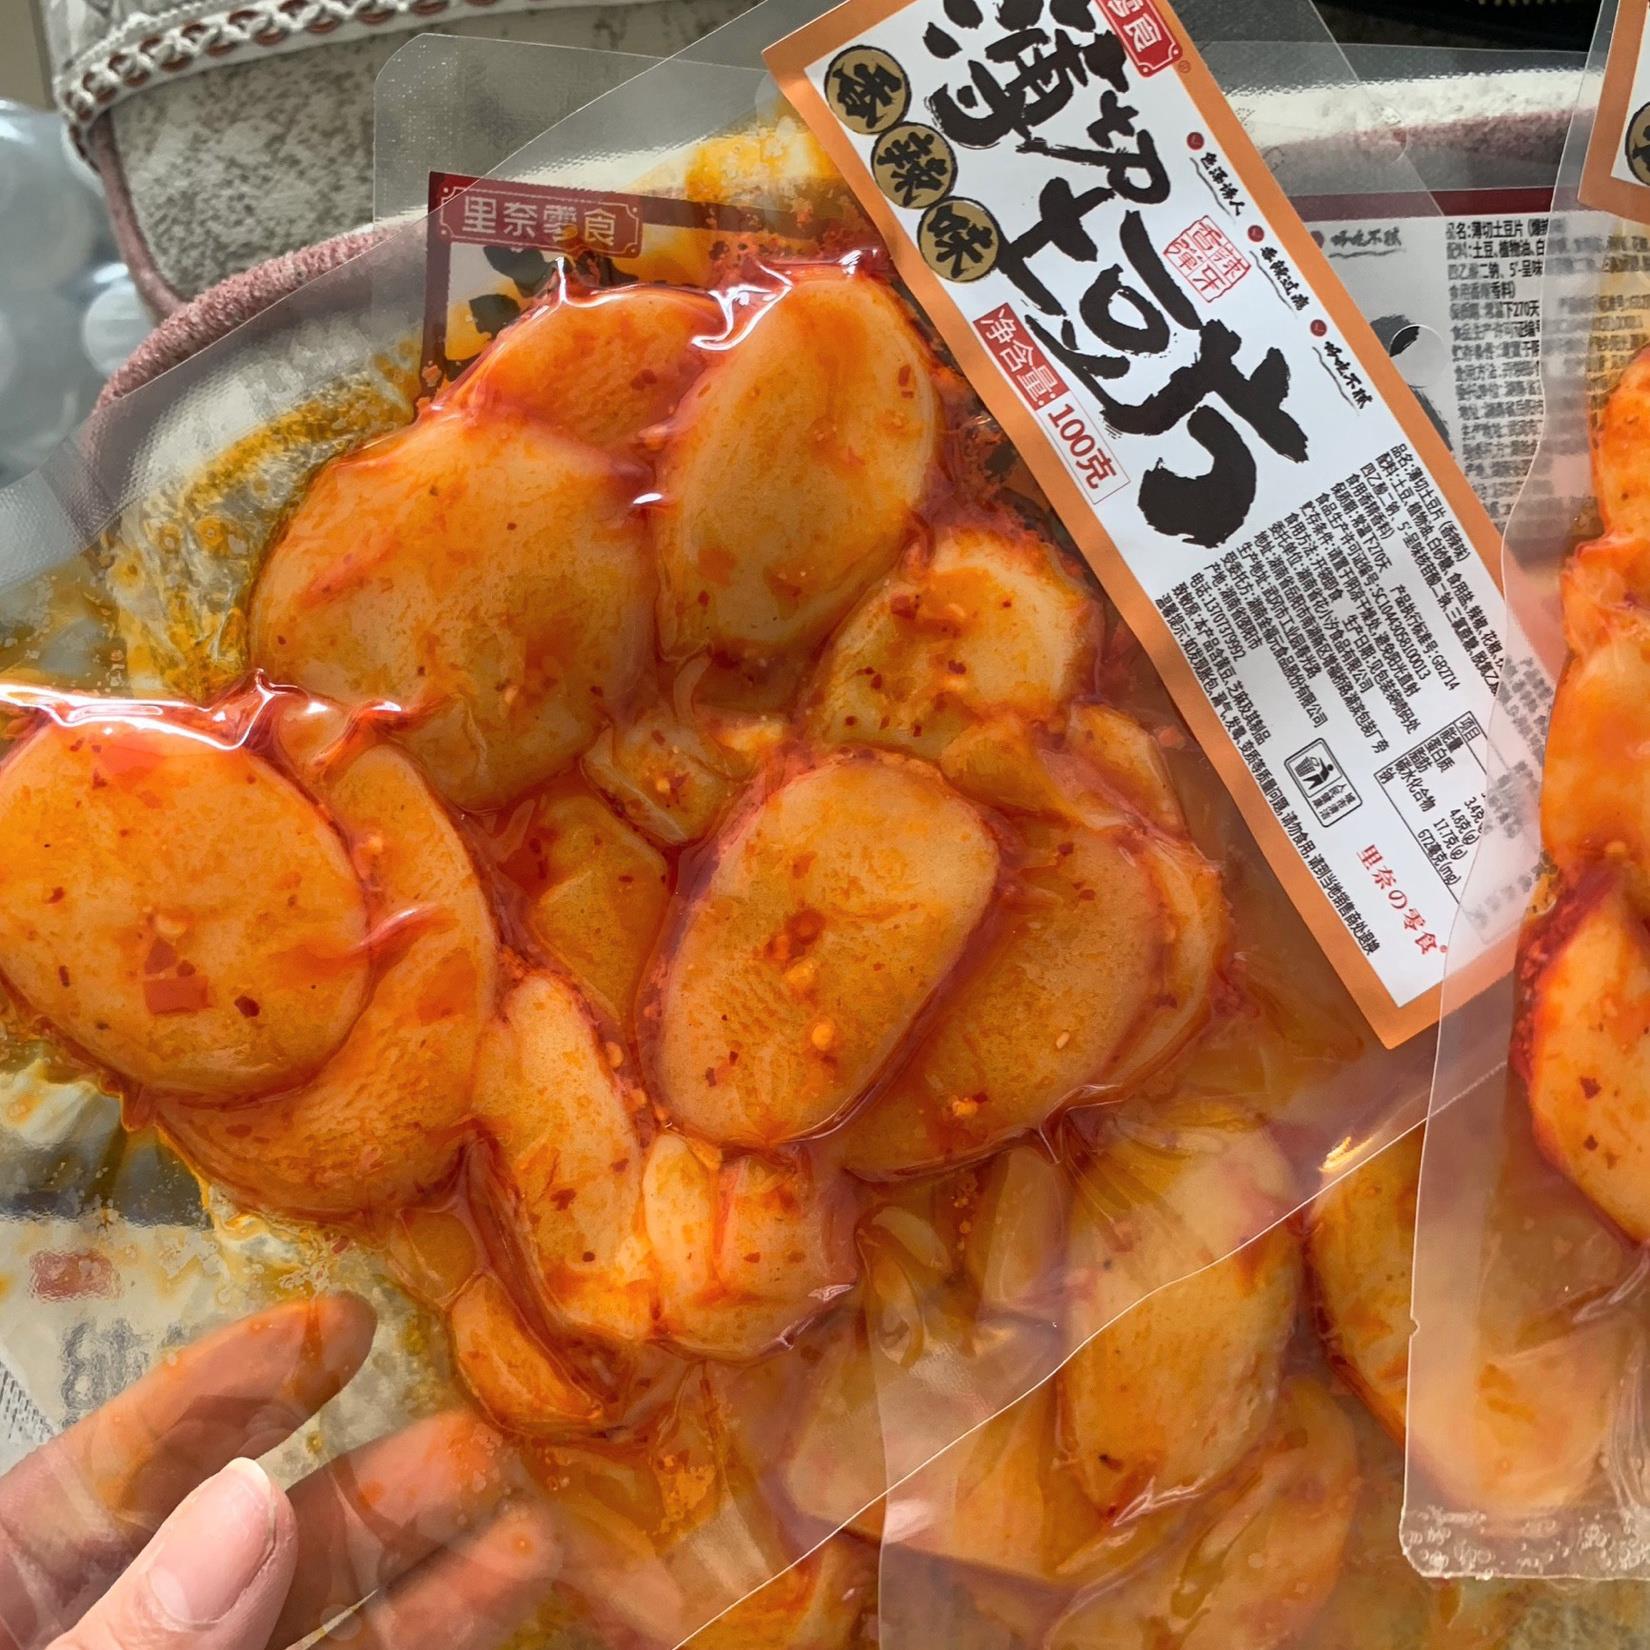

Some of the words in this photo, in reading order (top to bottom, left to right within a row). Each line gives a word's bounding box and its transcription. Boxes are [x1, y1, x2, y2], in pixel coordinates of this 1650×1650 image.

[833, 63, 993, 279] 香辣味
[462, 196, 616, 247] 里奈零食
[923, 0, 1307, 549] 薄切土豆片
[981, 309, 1058, 405] 净含量:
[1048, 404, 1116, 489] 100克
[1440, 727, 1464, 753] 能量
[1458, 717, 1480, 743] 项目
[1376, 768, 1396, 784] 钠
[1408, 747, 1432, 772] 脂肪
[1424, 737, 1454, 772] 蛋白质
[1359, 844, 1442, 954] 里奈の零食
